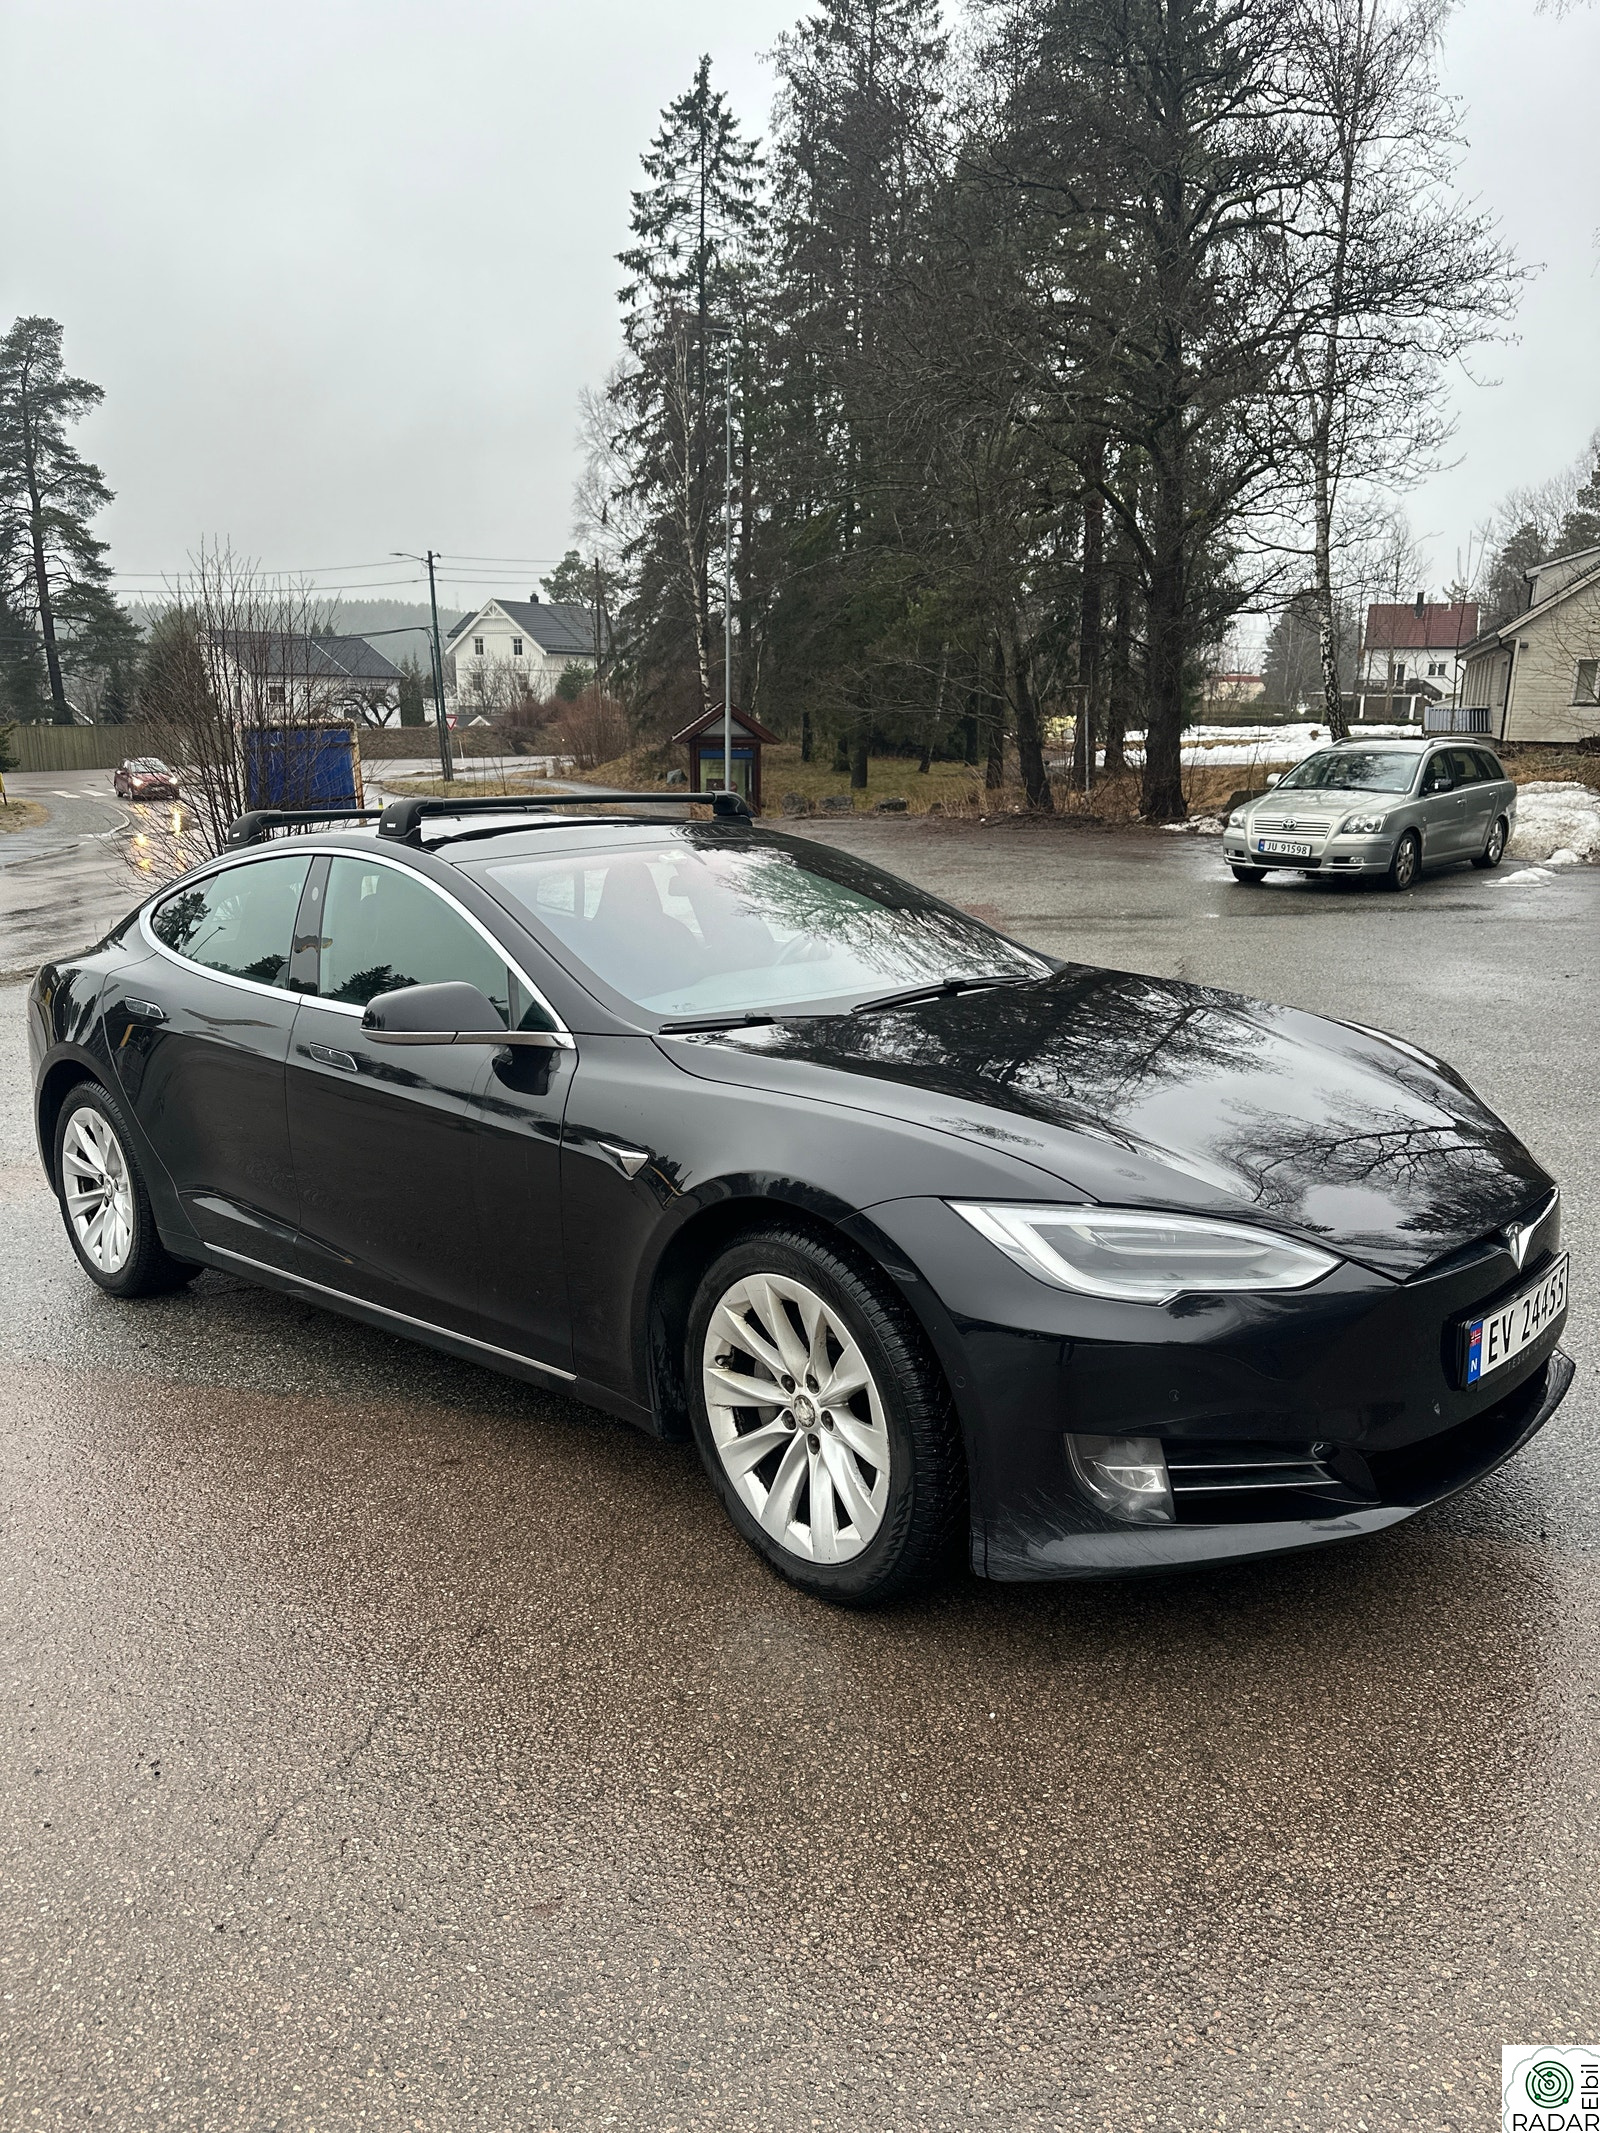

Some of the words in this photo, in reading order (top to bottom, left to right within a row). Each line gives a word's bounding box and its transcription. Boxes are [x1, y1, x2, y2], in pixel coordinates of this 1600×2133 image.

[1267, 842, 1278, 851] JU
[1281, 843, 1307, 855] 91598
[1488, 1309, 1515, 1365] EV
[1521, 1266, 1566, 1343] 24455
[1470, 1357, 1478, 1373] N
